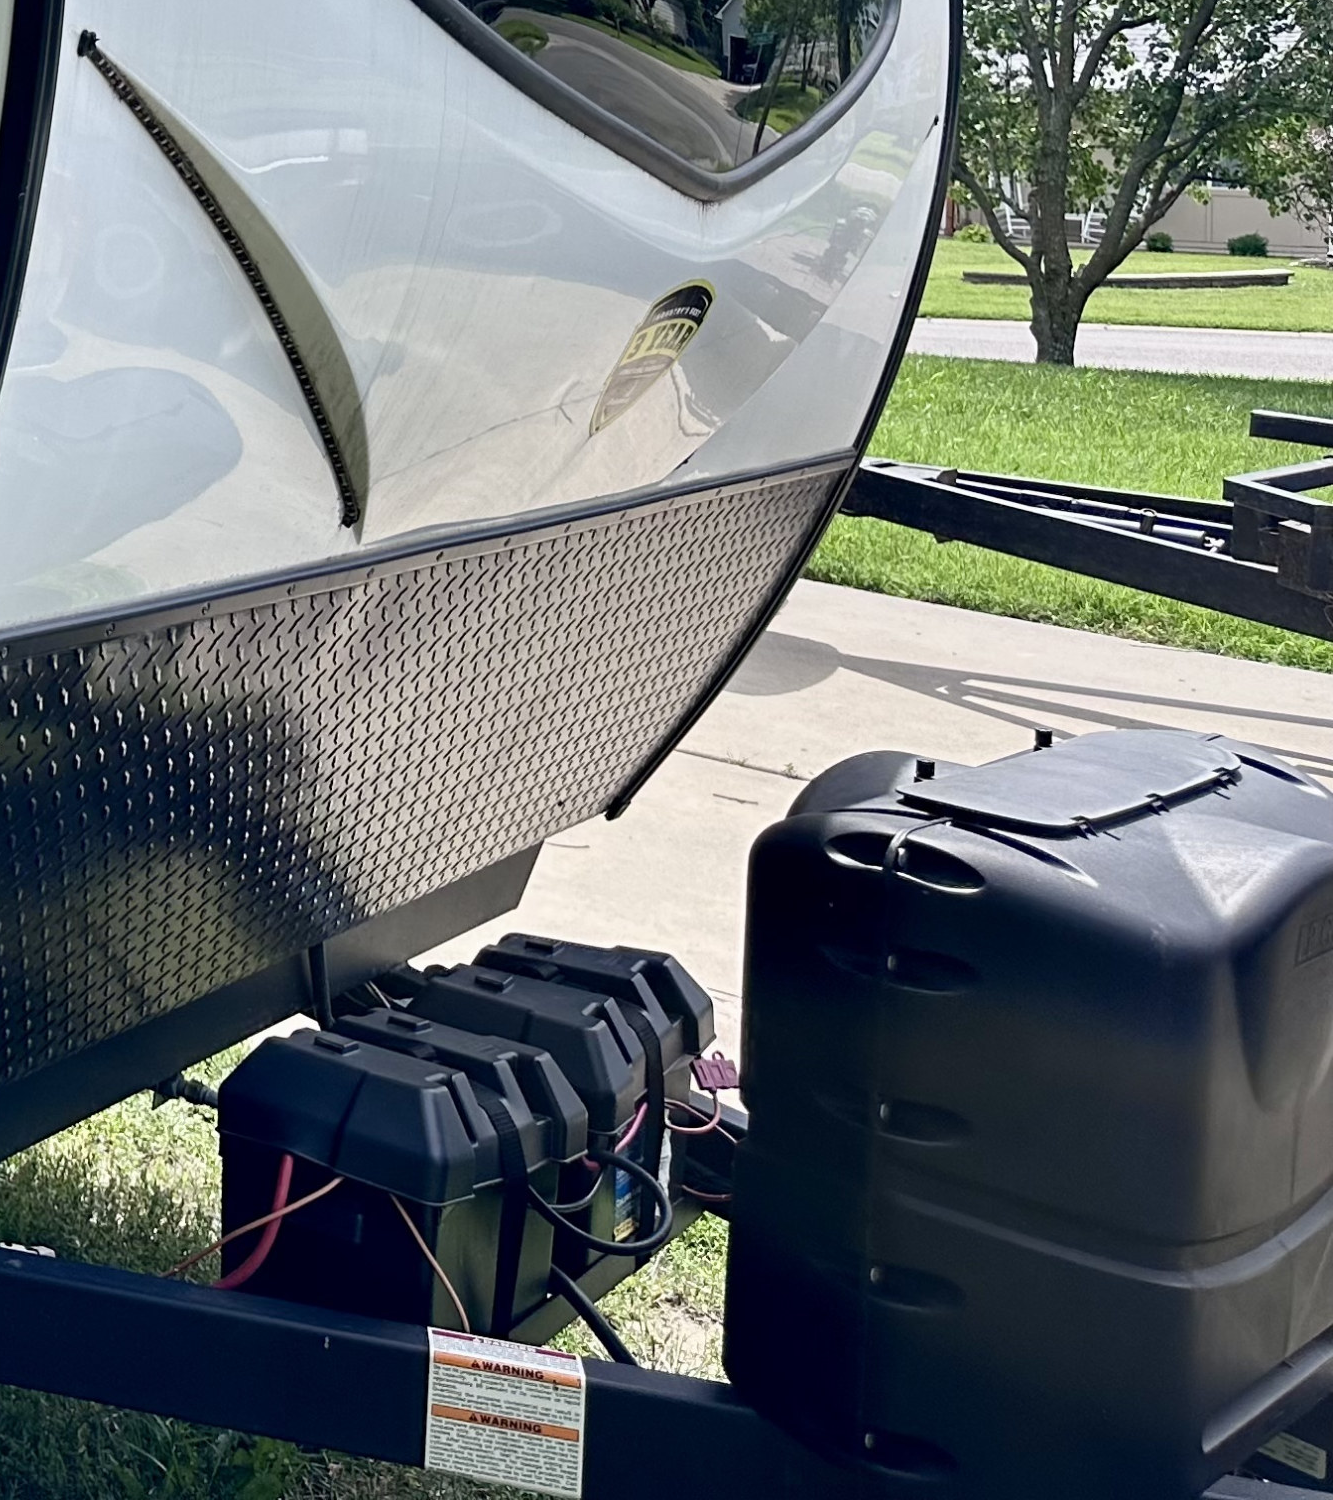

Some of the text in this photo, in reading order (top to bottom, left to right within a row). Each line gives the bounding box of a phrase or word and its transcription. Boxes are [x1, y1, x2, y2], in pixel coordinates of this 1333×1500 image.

[626, 323, 694, 360] 3 YEAR
[481, 1360, 545, 1380] WARNING
[479, 1414, 542, 1434] WARNING
